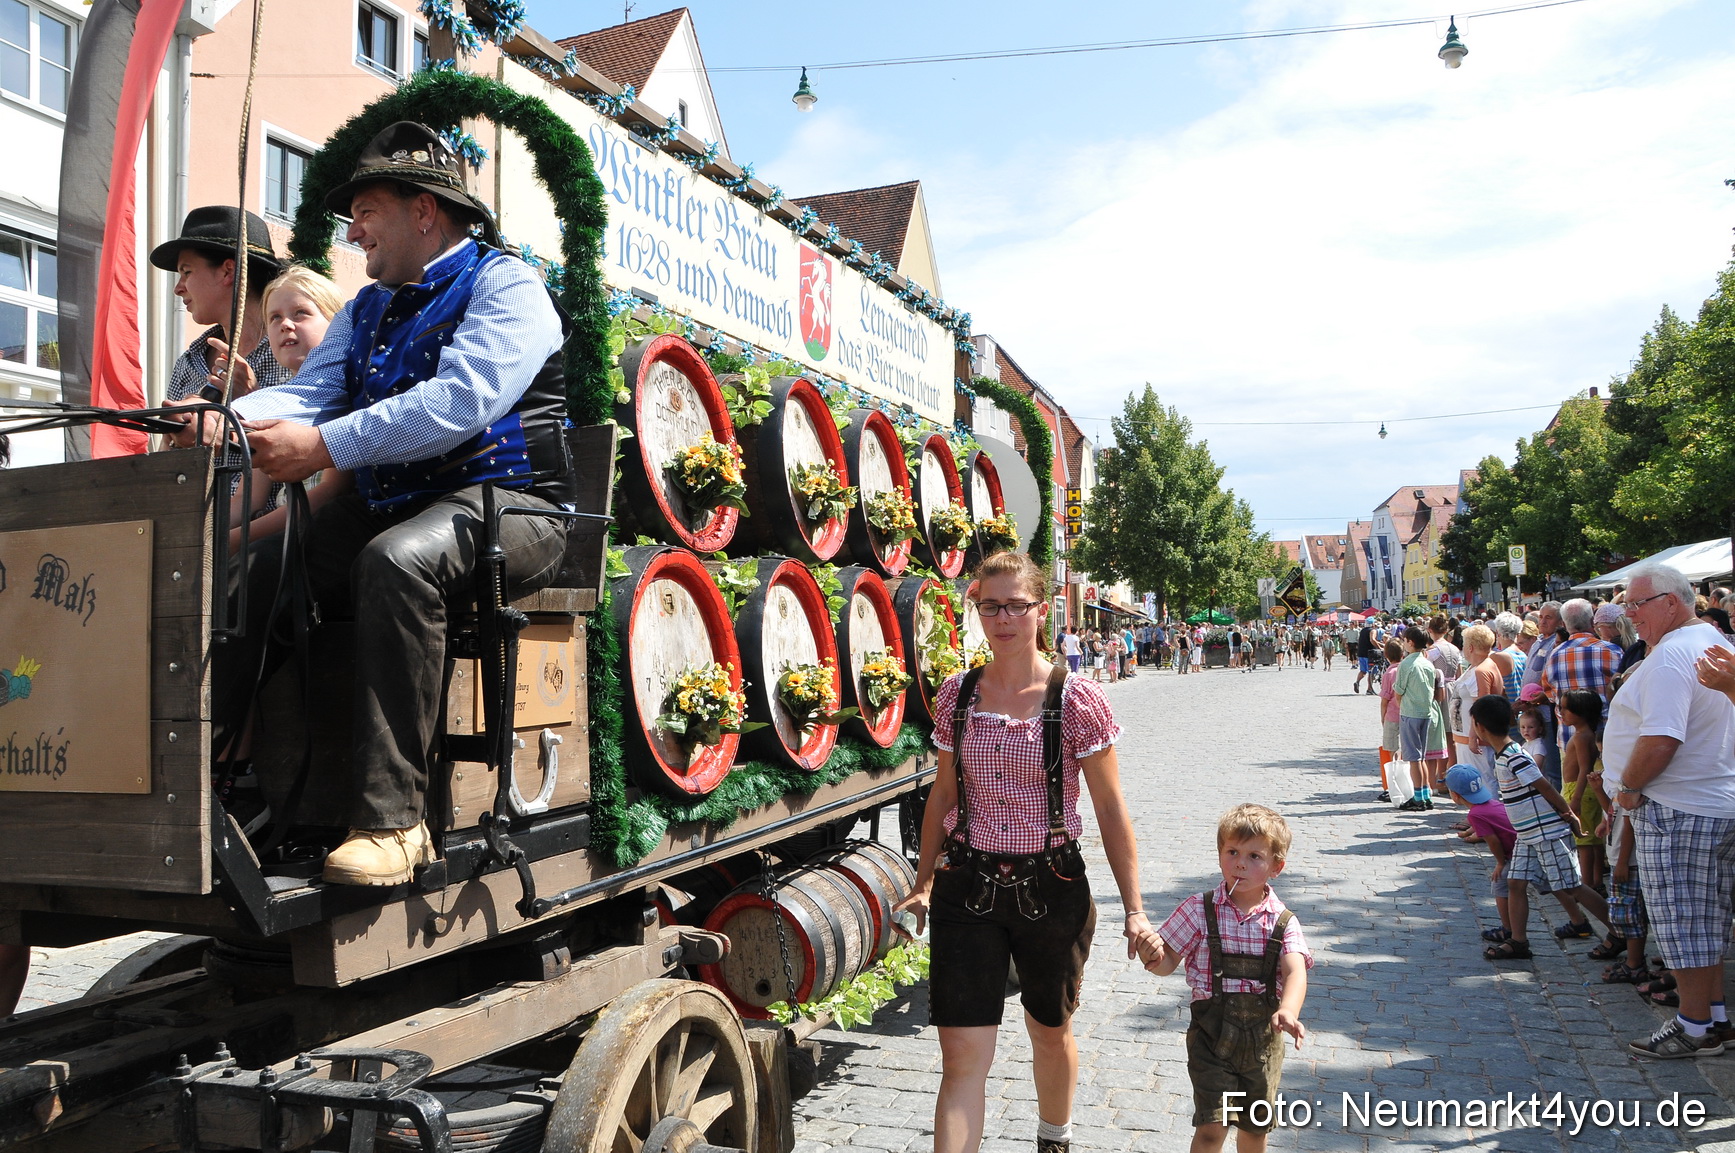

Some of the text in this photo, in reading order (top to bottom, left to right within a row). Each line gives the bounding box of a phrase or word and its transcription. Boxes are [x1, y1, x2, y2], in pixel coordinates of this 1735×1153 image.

[588, 122, 709, 244] Winkler
[714, 196, 779, 282] Bräu
[615, 221, 671, 287] 1628
[676, 257, 718, 308] und
[722, 267, 793, 349] dennoch
[860, 285, 928, 364] Lengenfeld
[838, 326, 941, 412] das Bier von heute
[30, 553, 97, 628] Malz
